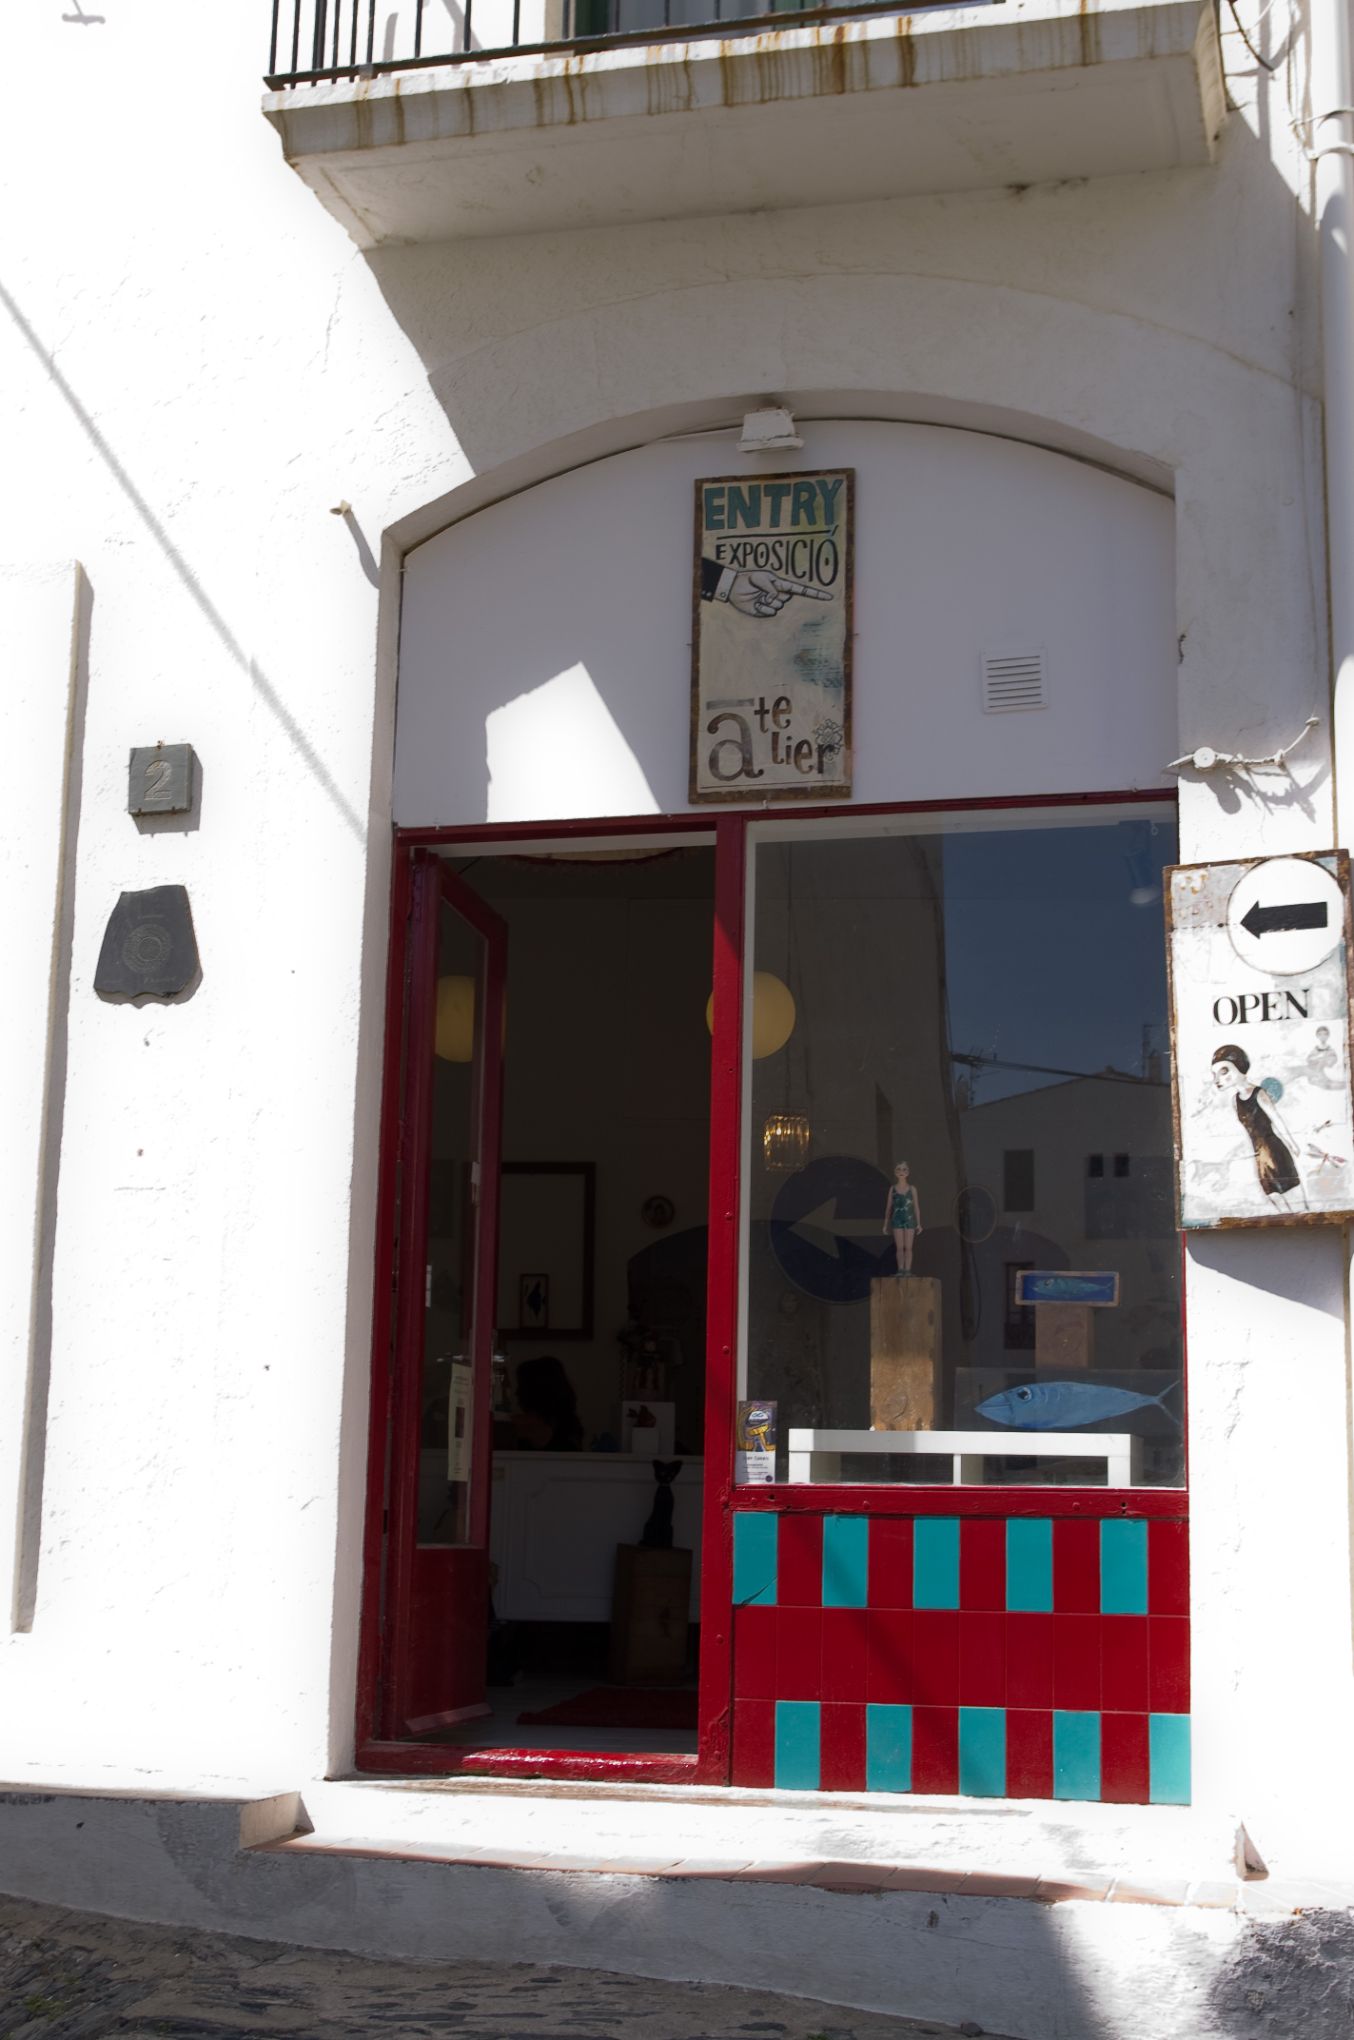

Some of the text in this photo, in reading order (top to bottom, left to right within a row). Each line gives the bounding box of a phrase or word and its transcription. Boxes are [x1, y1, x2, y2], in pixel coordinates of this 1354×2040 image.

[704, 479, 844, 531] ENTRY
[716, 525, 838, 587] EXPOSICIÓ
[143, 759, 173, 800] 2
[1213, 989, 1309, 1025] OPEN
